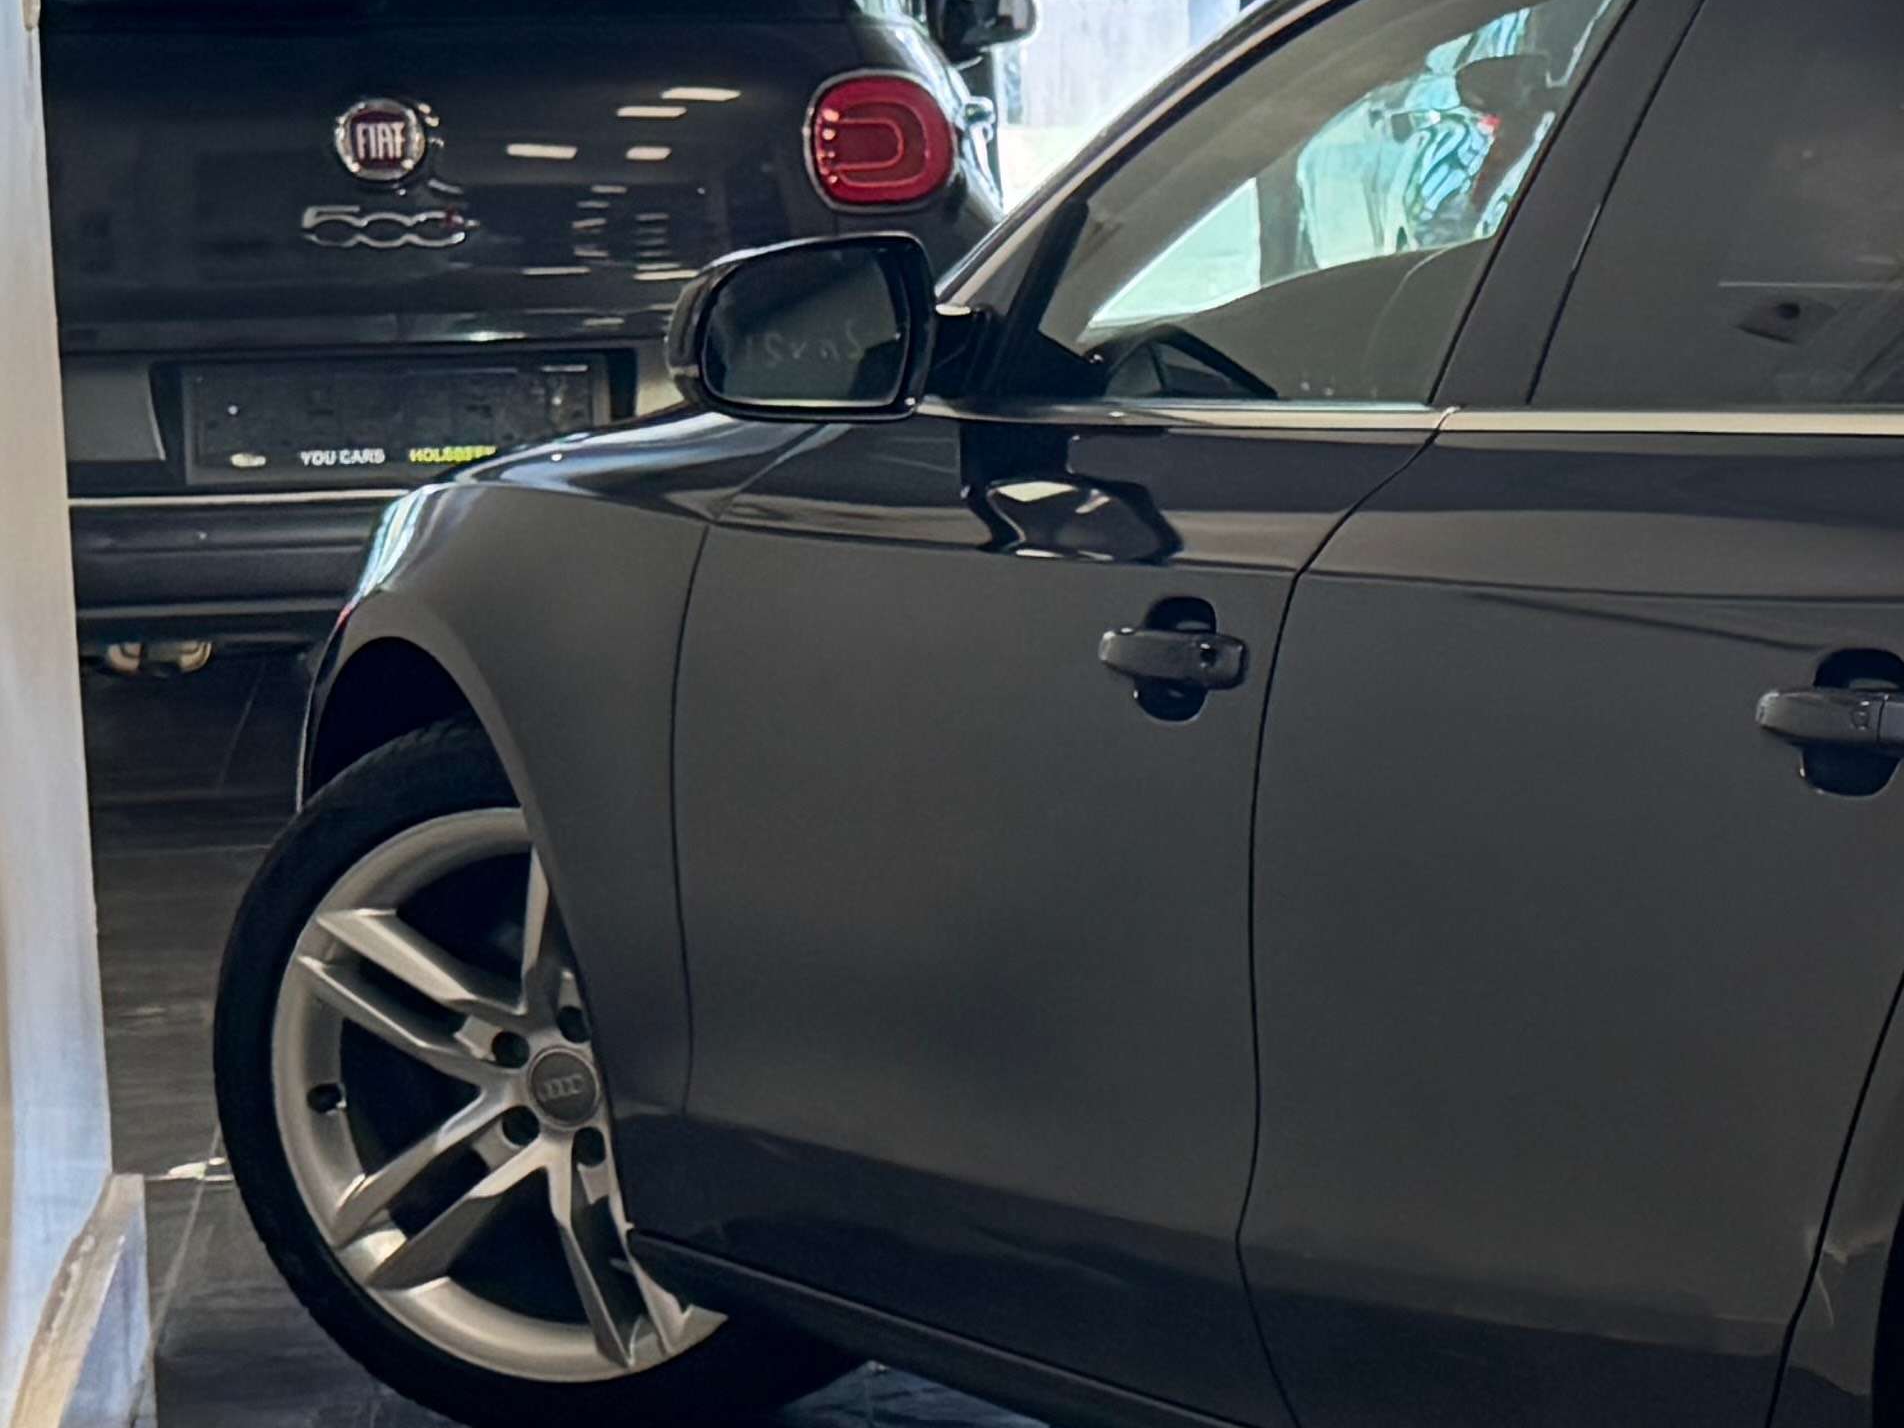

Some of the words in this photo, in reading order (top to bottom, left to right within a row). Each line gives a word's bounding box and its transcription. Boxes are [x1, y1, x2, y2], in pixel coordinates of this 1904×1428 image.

[354, 122, 406, 160] FIAT
[300, 450, 337, 466] YOU
[339, 448, 386, 464] CARS
